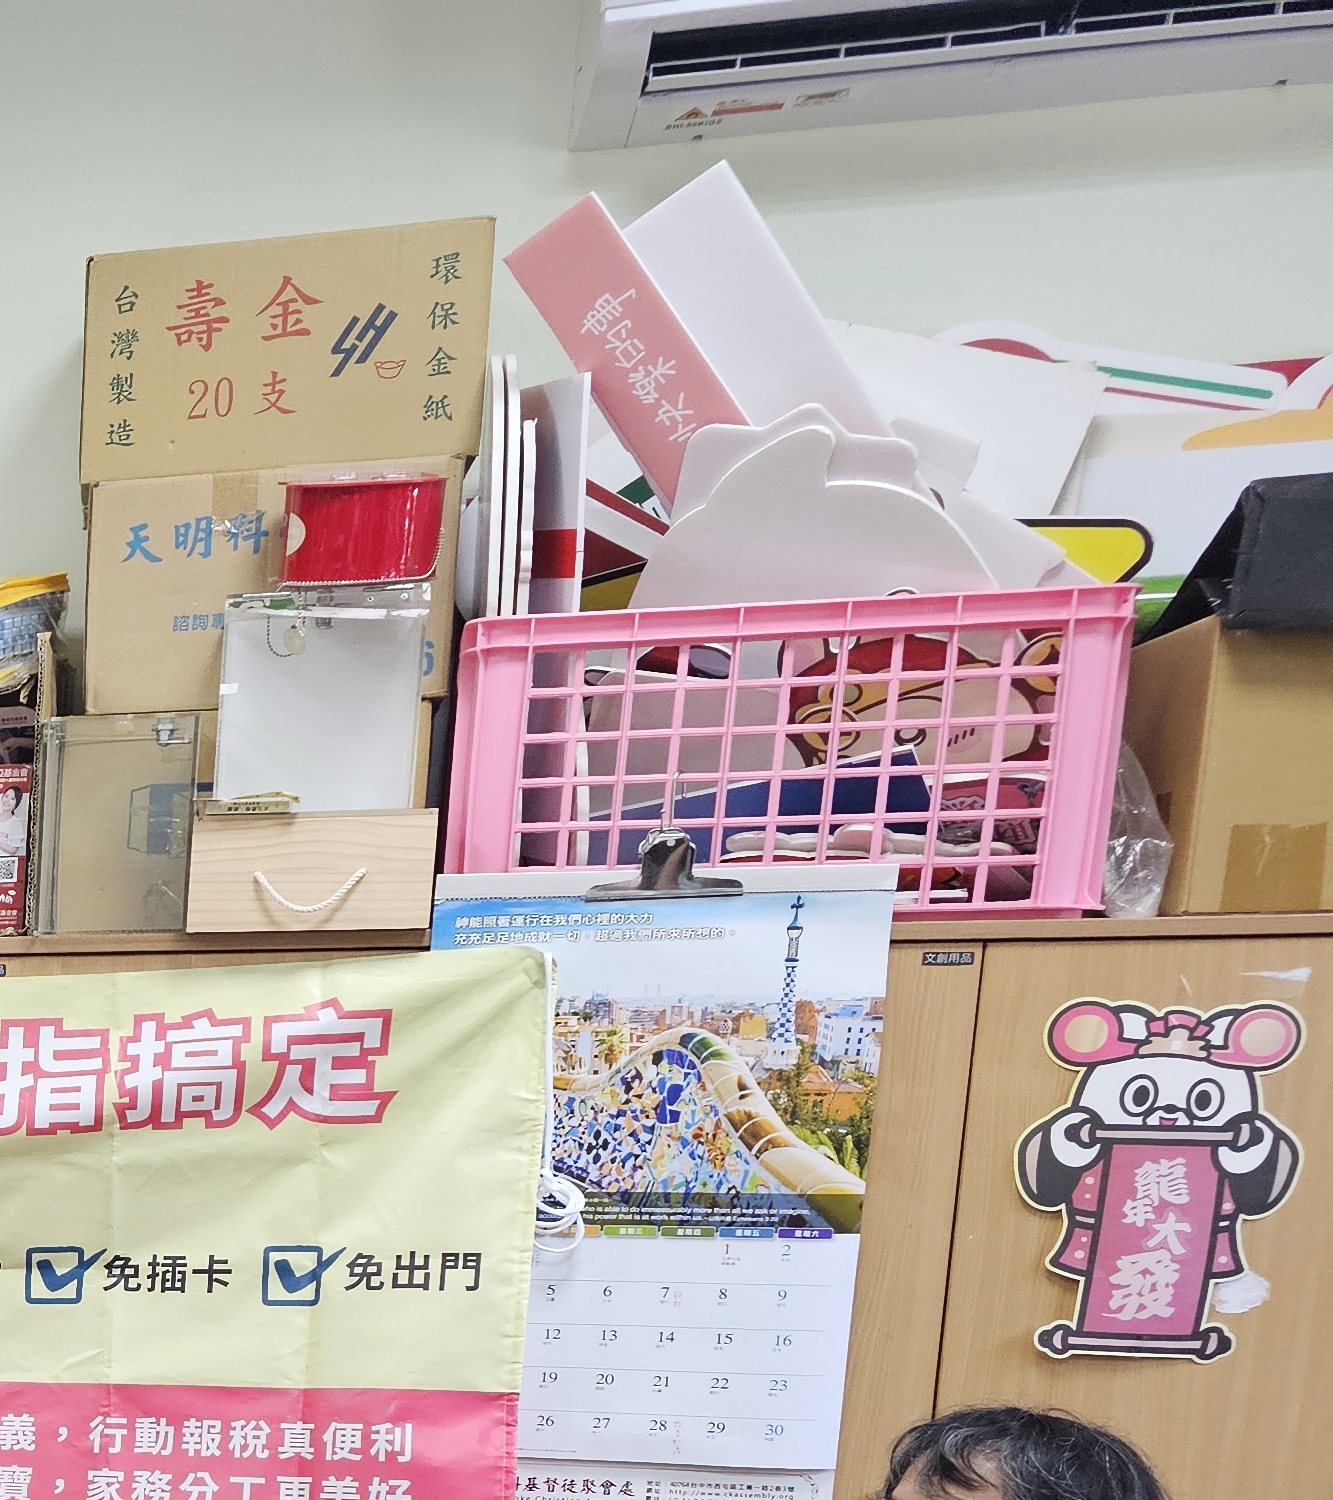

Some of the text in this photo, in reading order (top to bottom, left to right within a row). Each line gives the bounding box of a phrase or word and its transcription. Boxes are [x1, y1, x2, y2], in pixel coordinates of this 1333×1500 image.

[166, 275, 324, 353] 壽金
[422, 251, 462, 423] 環保金紙
[105, 285, 140, 448] 台灣製造
[187, 370, 297, 420] 20支
[121, 509, 284, 564] 天明科
[924, 953, 972, 963] 文創用品
[724, 1244, 791, 1256] 1 2
[1101, 1157, 1192, 1321] 龍年大發
[103, 1254, 232, 1295] 免插卡
[345, 1251, 483, 1293] 免出門
[546, 1284, 556, 1295] 5
[603, 1285, 612, 1296] 6
[661, 1286, 670, 1298] 7
[718, 1288, 728, 1299] 8
[778, 1289, 787, 1302] 9
[544, 1328, 561, 1340] 12
[601, 1330, 618, 1341] 13
[658, 1331, 675, 1343] 14
[716, 1333, 733, 1344] 15
[775, 1334, 792, 1347] 16
[541, 1371, 557, 1383] 19
[595, 1373, 615, 1385] 20
[652, 1375, 670, 1387] 21
[710, 1377, 729, 1389] 22
[769, 1379, 787, 1391] 23
[536, 1415, 554, 1426] 26
[592, 1417, 610, 1429] 27
[649, 1419, 667, 1431] 28
[707, 1421, 725, 1433] 29
[764, 1424, 783, 1436] 30
